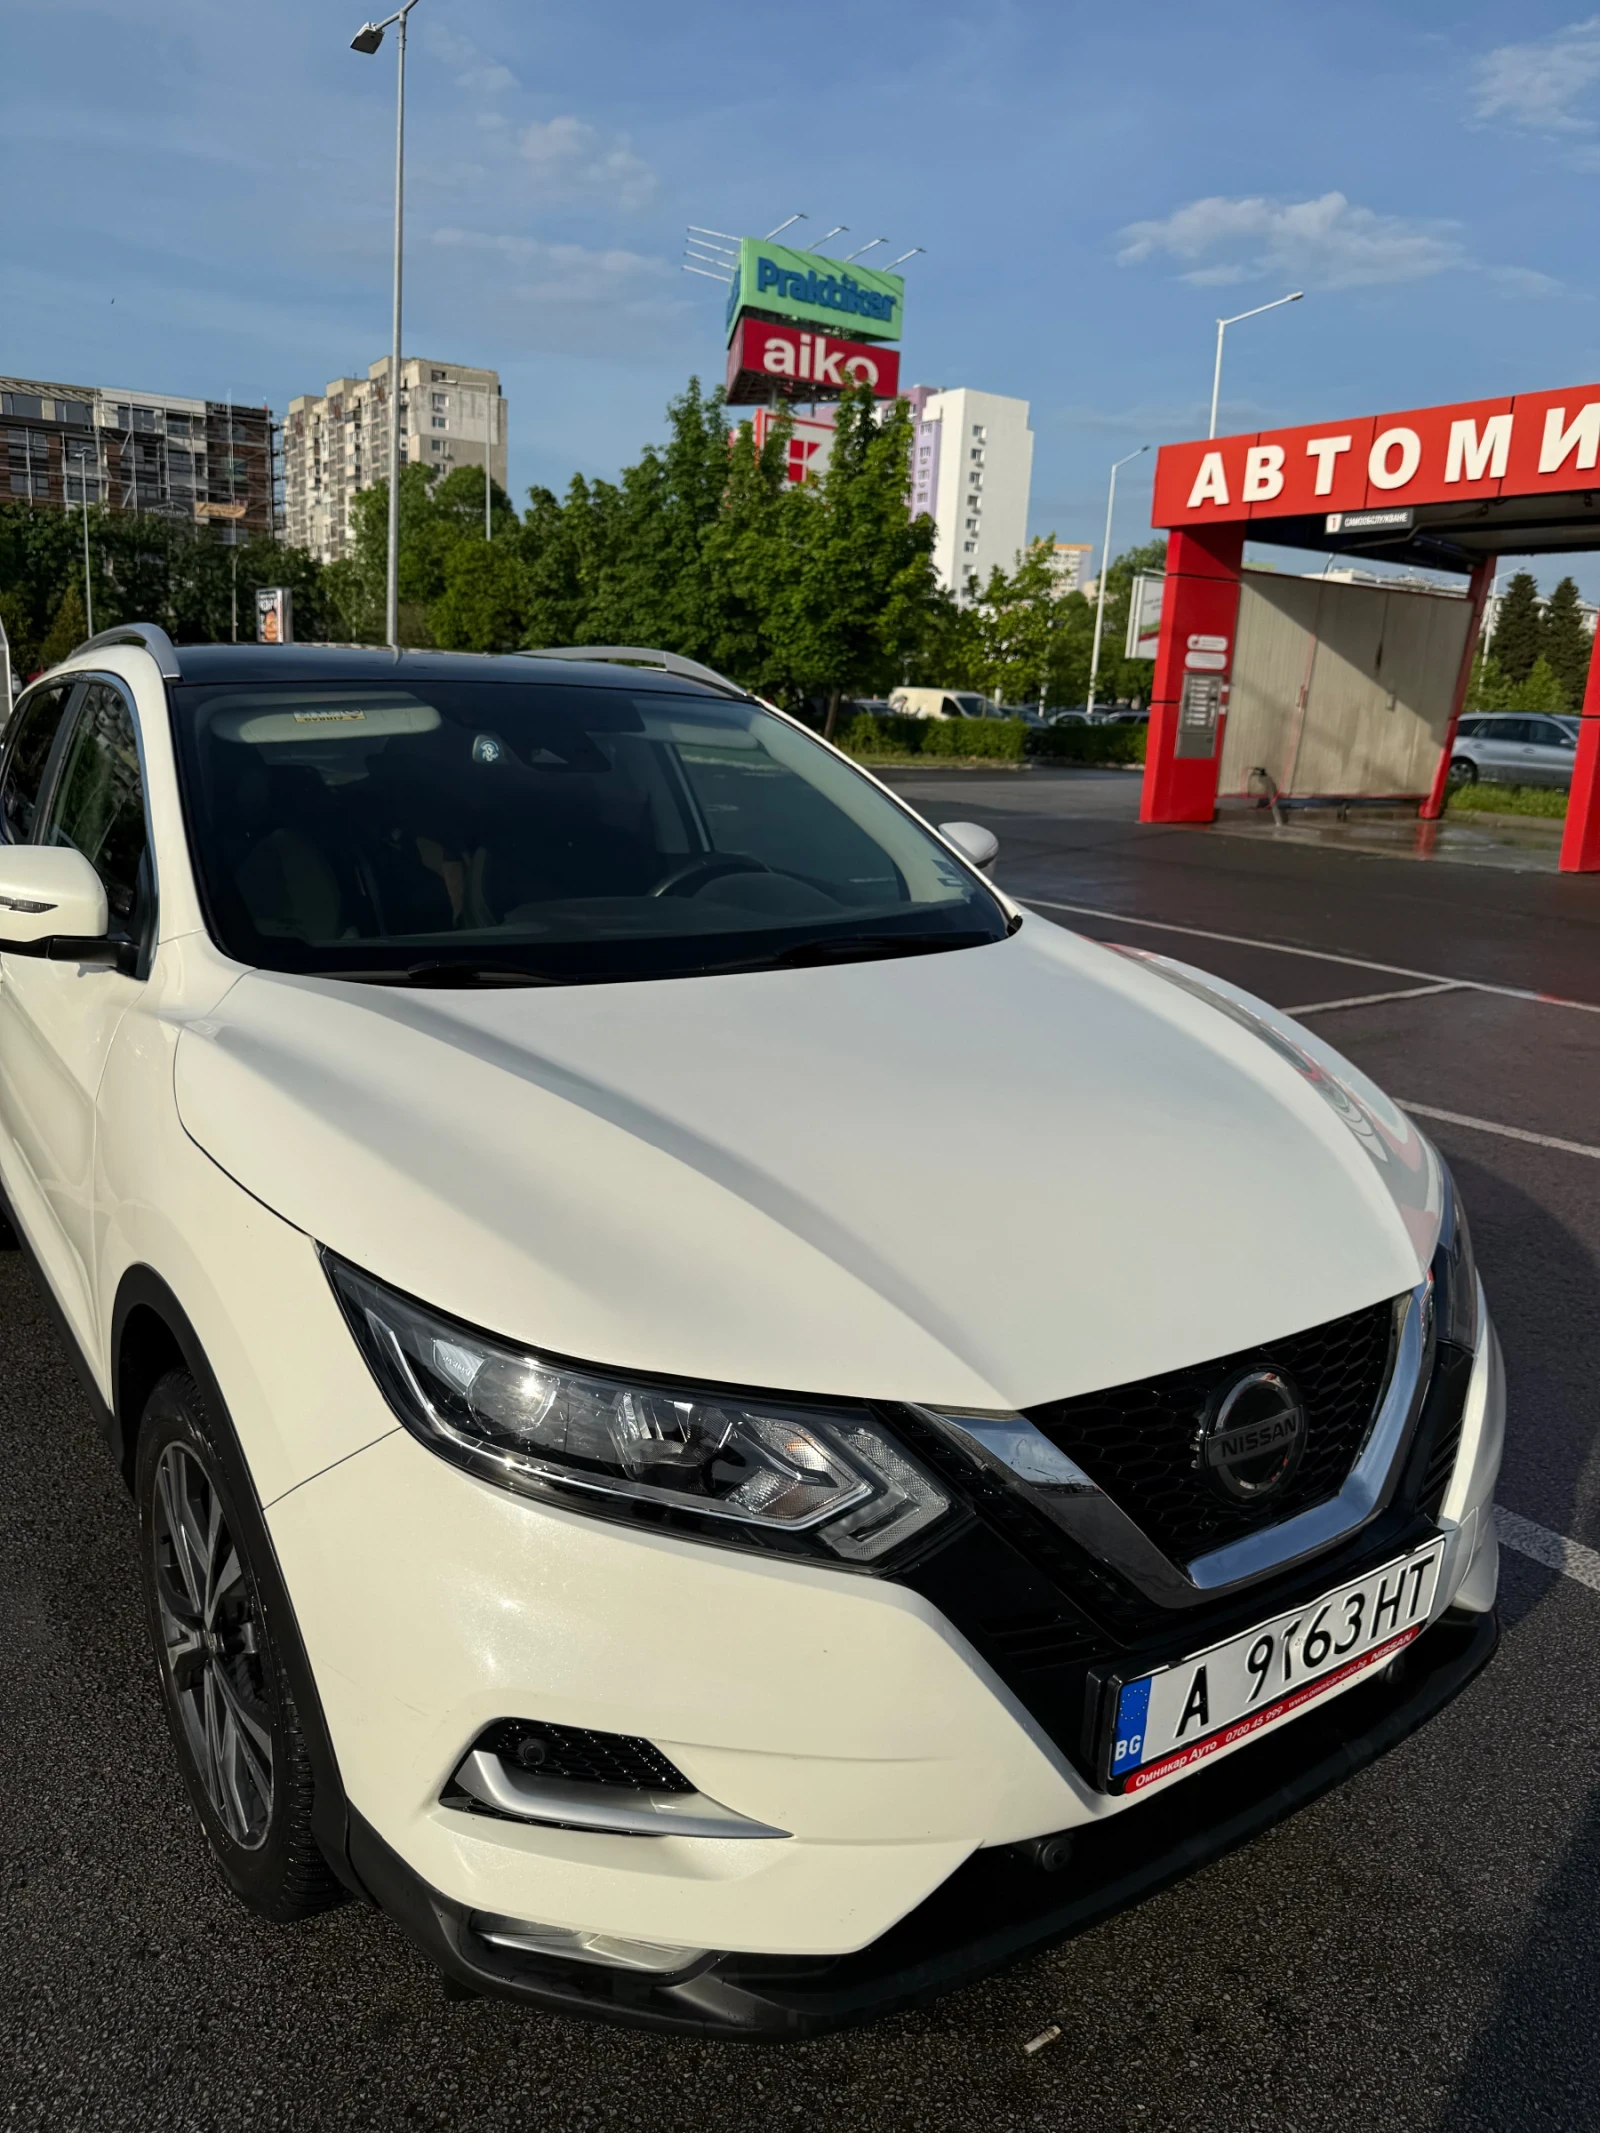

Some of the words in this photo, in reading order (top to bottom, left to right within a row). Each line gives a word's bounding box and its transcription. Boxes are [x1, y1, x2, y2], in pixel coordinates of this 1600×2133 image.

[757, 256, 897, 322] Praktiker
[763, 334, 879, 390] aiko
[1187, 402, 1600, 508] АВТОМИ
[1221, 1414, 1297, 1458] NISSAN
[1136, 1755, 1187, 1787] Омникар
[1189, 1741, 1217, 1760] Ауто
[1225, 1723, 1250, 1742] 0700
[1251, 1716, 1264, 1729] 45
[1265, 1705, 1284, 1722] 999
[1288, 1659, 1367, 1708] www.omnicar-auto.bg
[1371, 1632, 1413, 1662] NISSAN
[1114, 1734, 1142, 1762] BG
